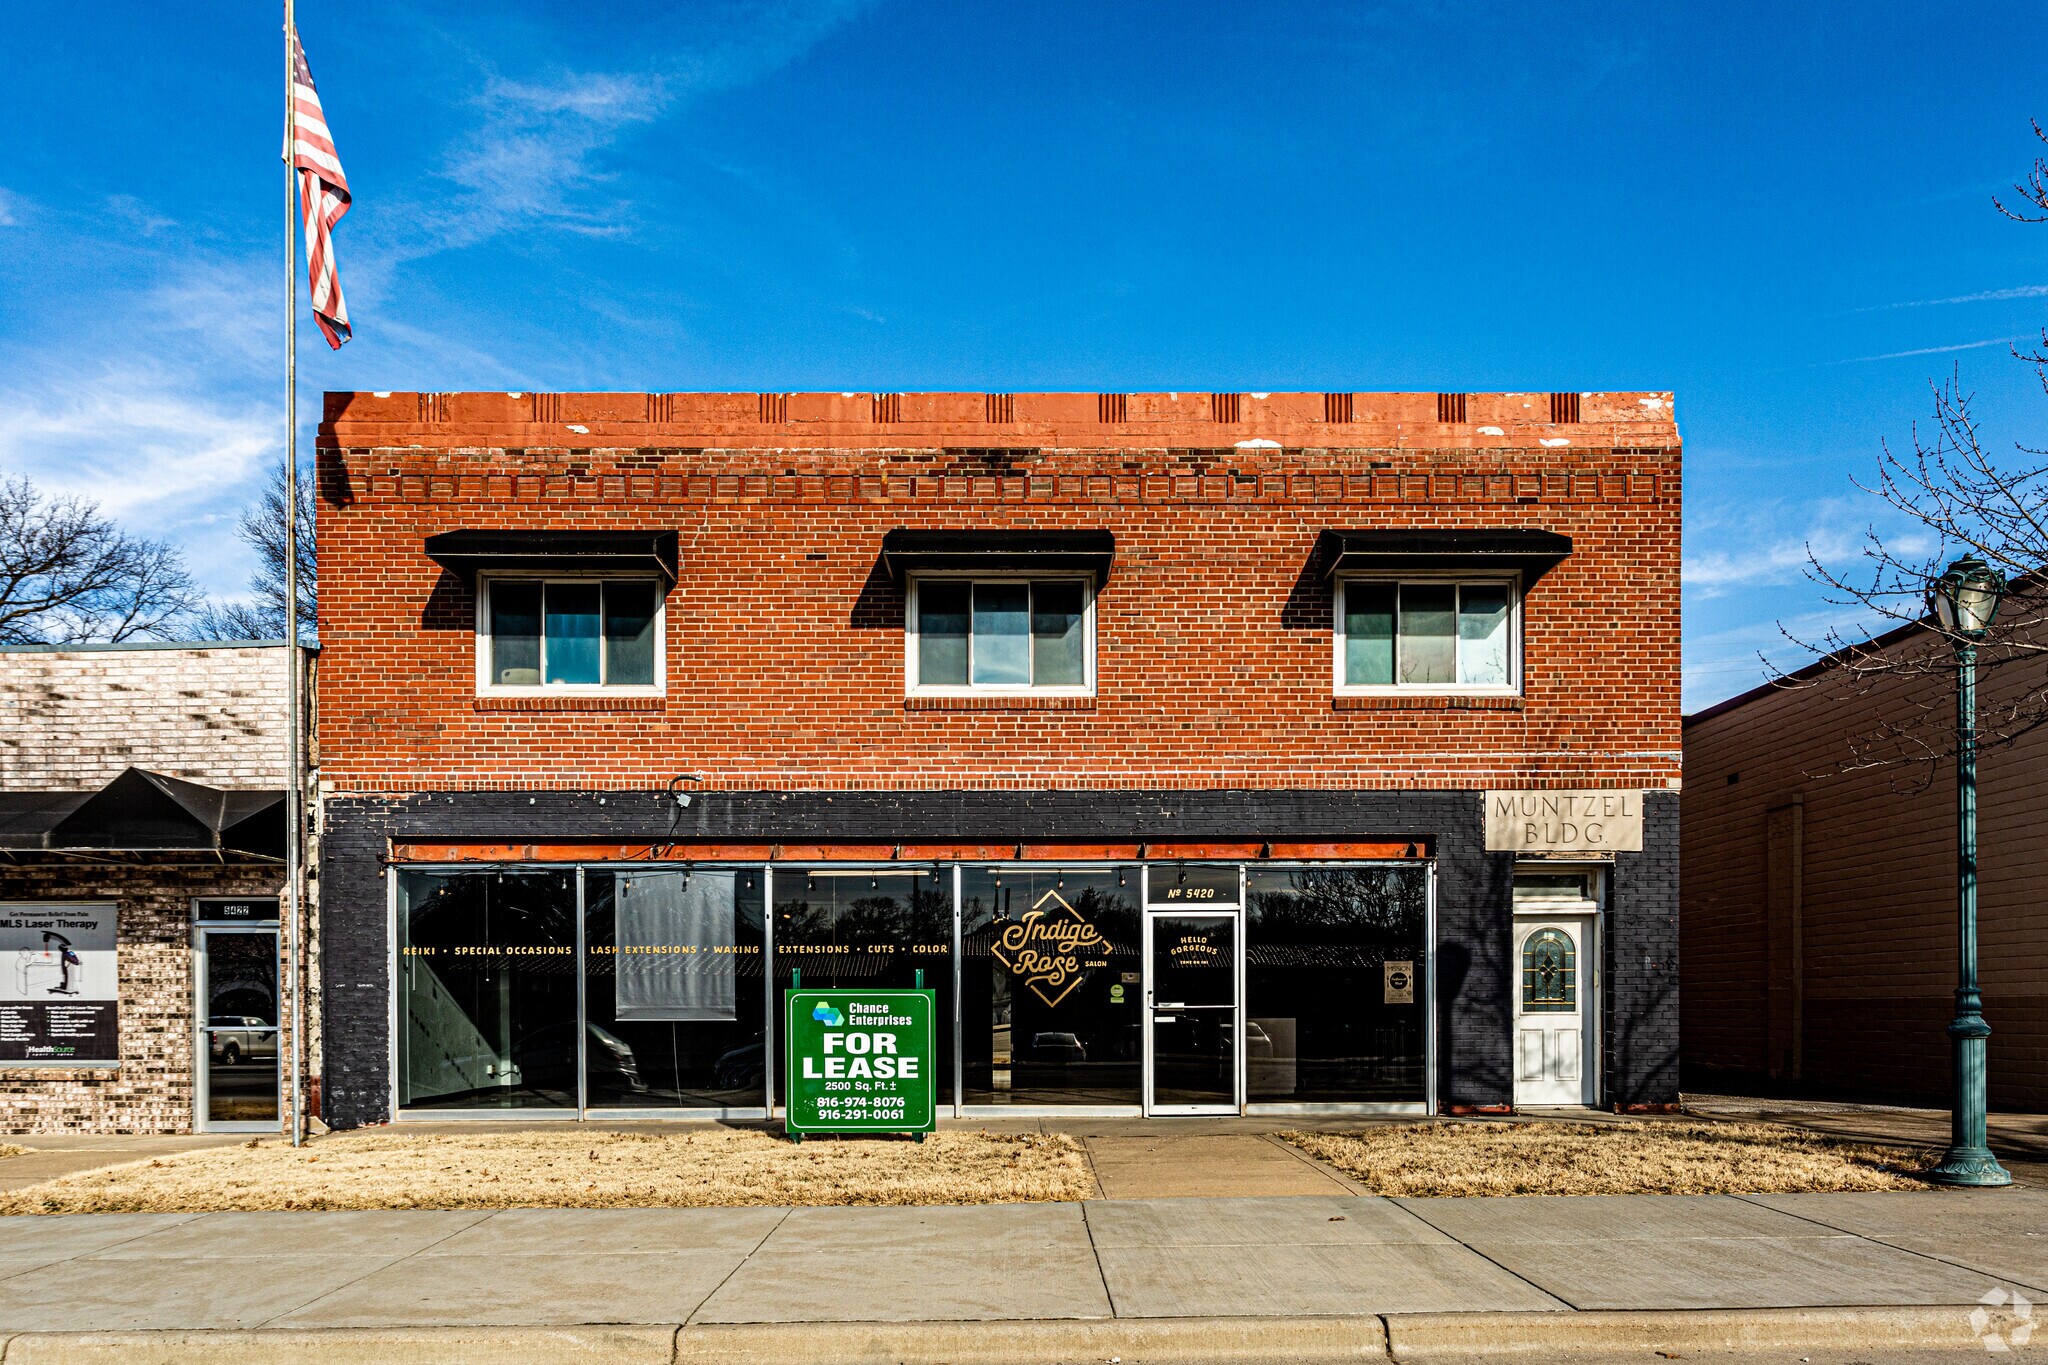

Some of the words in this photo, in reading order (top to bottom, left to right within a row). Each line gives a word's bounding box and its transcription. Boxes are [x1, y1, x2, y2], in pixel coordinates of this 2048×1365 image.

[1495, 796, 1633, 818] MUNTZEL
[1524, 822, 1608, 844] BLDG.
[1186, 889, 1214, 898] 5420
[224, 906, 249, 915] 5422
[0, 919, 22, 928] MLS
[25, 919, 54, 928] Laser
[56, 919, 98, 930] Therapy
[1003, 911, 1103, 952] Indigo
[1180, 936, 1207, 944] HELLO
[403, 947, 436, 955] REIKI
[454, 946, 501, 955] SPECIAL
[506, 946, 572, 955] OCCASIONS
[590, 945, 620, 954] LASH
[625, 945, 697, 954] EXTENSIONS
[713, 945, 760, 954] WAXING
[778, 945, 850, 954] EXTENSIONS
[867, 945, 895, 953] CUTS
[912, 945, 948, 953] COLOR
[1171, 945, 1218, 955] GORGEOUS
[1013, 950, 1079, 986] Rose
[849, 1003, 889, 1014] Chance
[849, 1015, 912, 1026] Enterprises
[823, 1032, 898, 1054] FOR
[28, 1045, 75, 1053] HealthSource
[803, 1057, 919, 1079] LEASE
[825, 1082, 851, 1091] 2500
[855, 1082, 872, 1092] Sq.
[875, 1082, 888, 1090] Ft.
[817, 1097, 905, 1107] 816-974-8076
[818, 1109, 904, 1120] 916-291-0061
